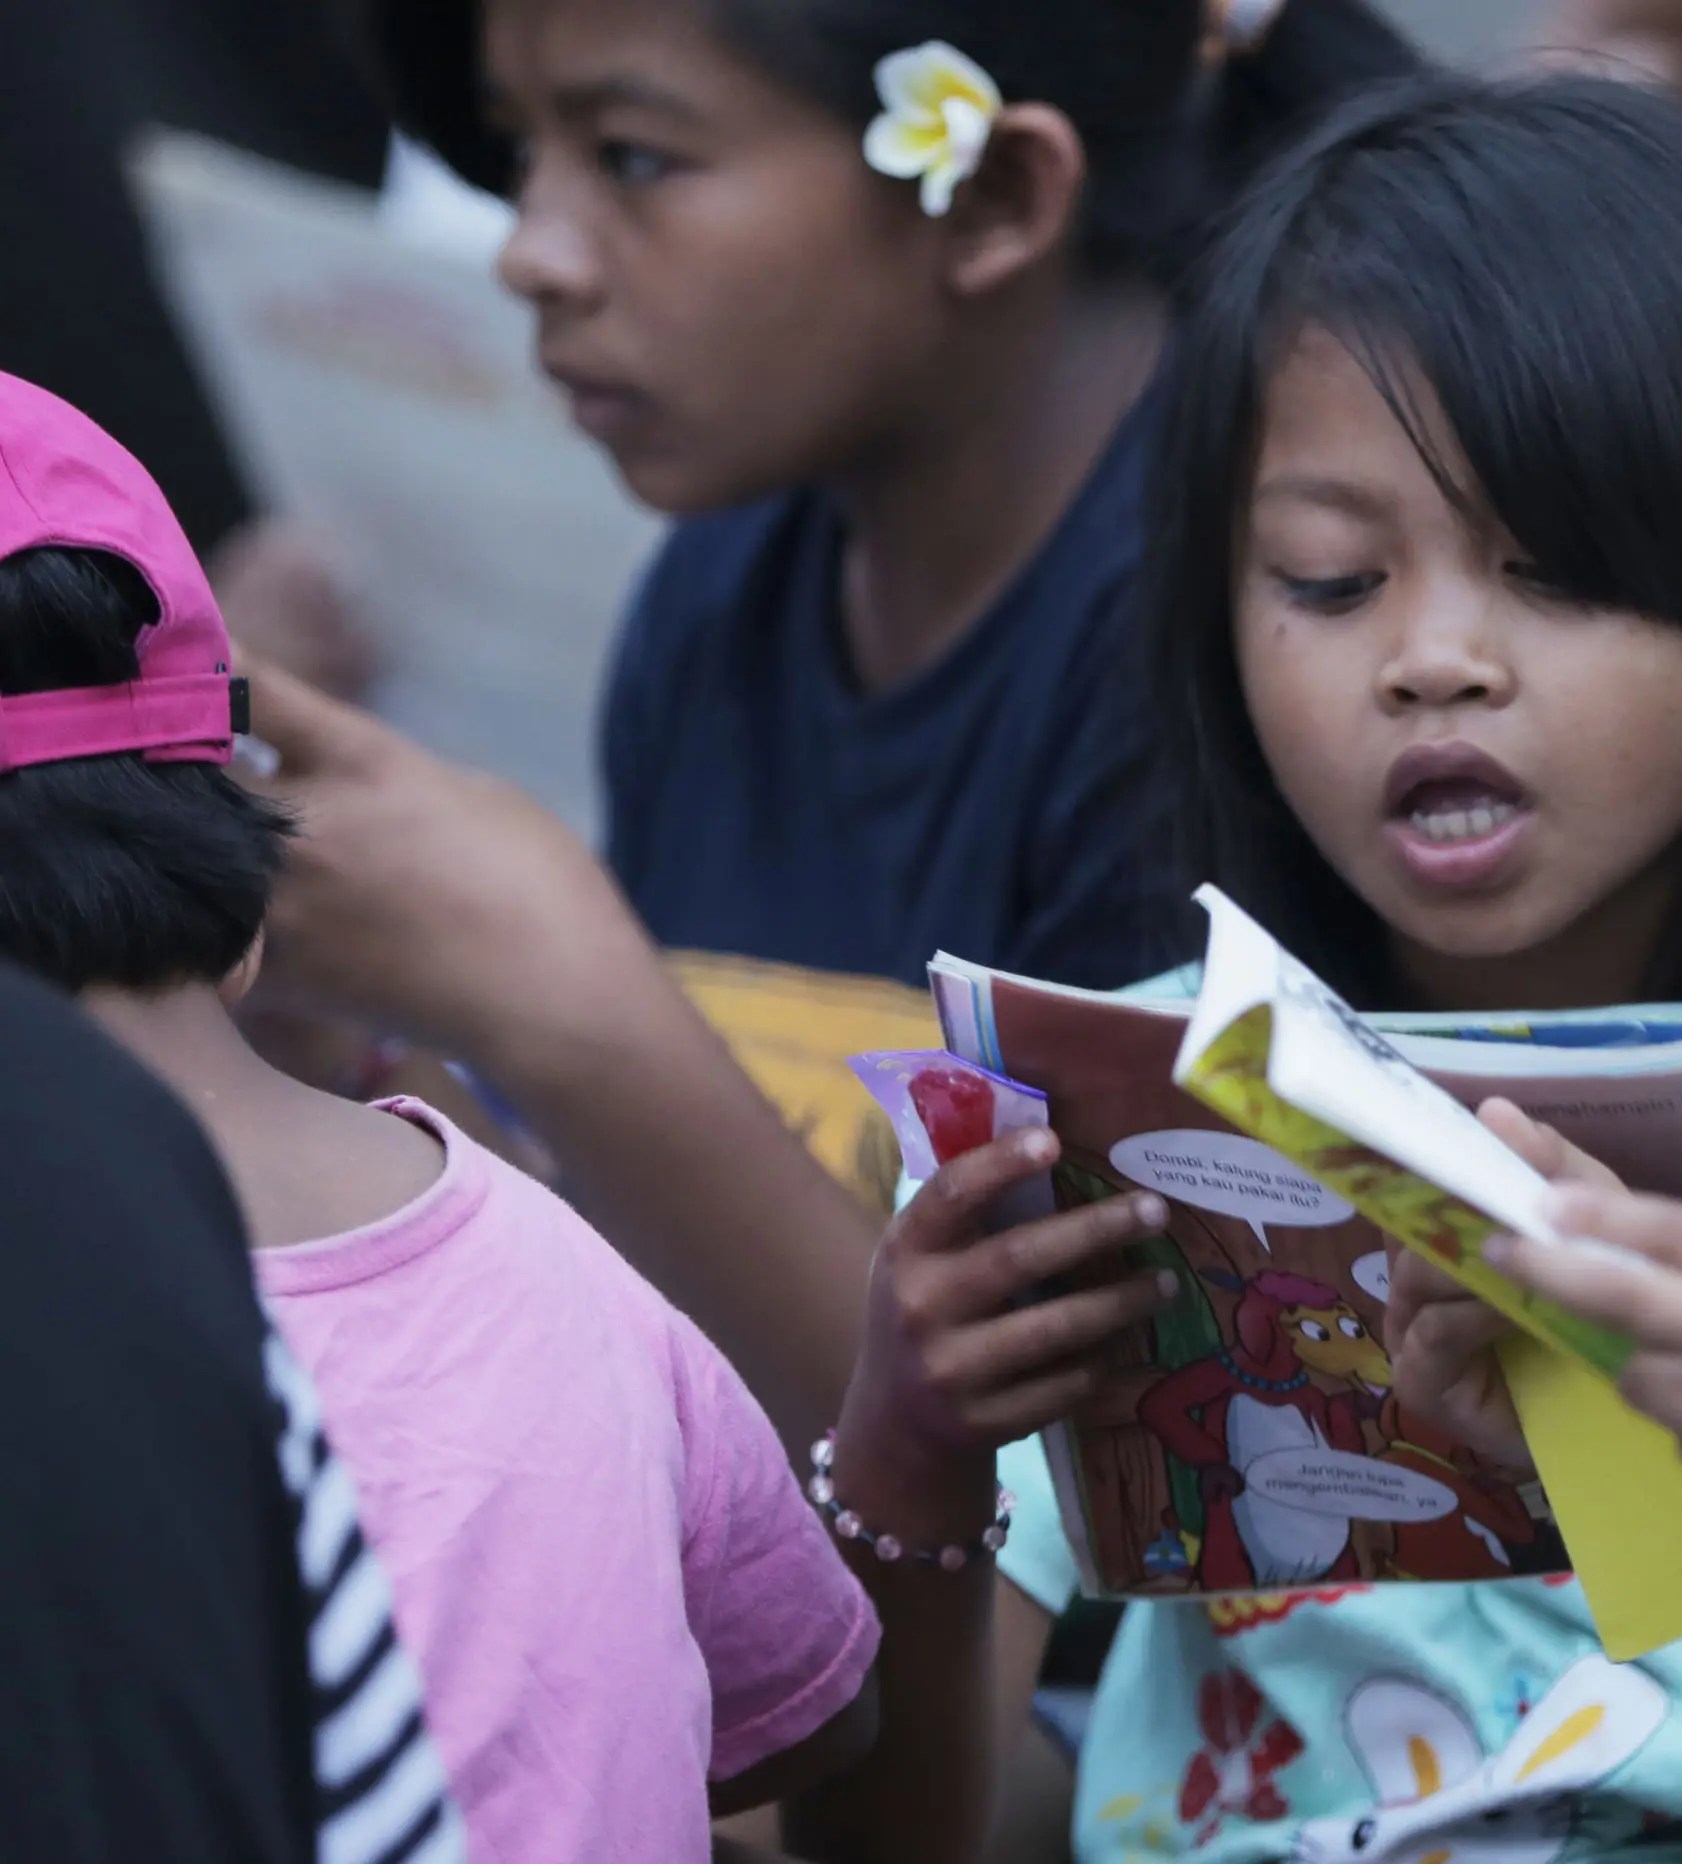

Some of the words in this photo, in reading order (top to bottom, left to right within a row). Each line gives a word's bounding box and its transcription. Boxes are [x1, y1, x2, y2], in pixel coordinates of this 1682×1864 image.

[1144, 1150, 1208, 1172] Dombi,
[1212, 1159, 1272, 1185] kalung
[1275, 1173, 1323, 1195] siapa
[1152, 1167, 1198, 1187] yang
[1201, 1174, 1234, 1192] kau
[1238, 1182, 1285, 1203] pakai
